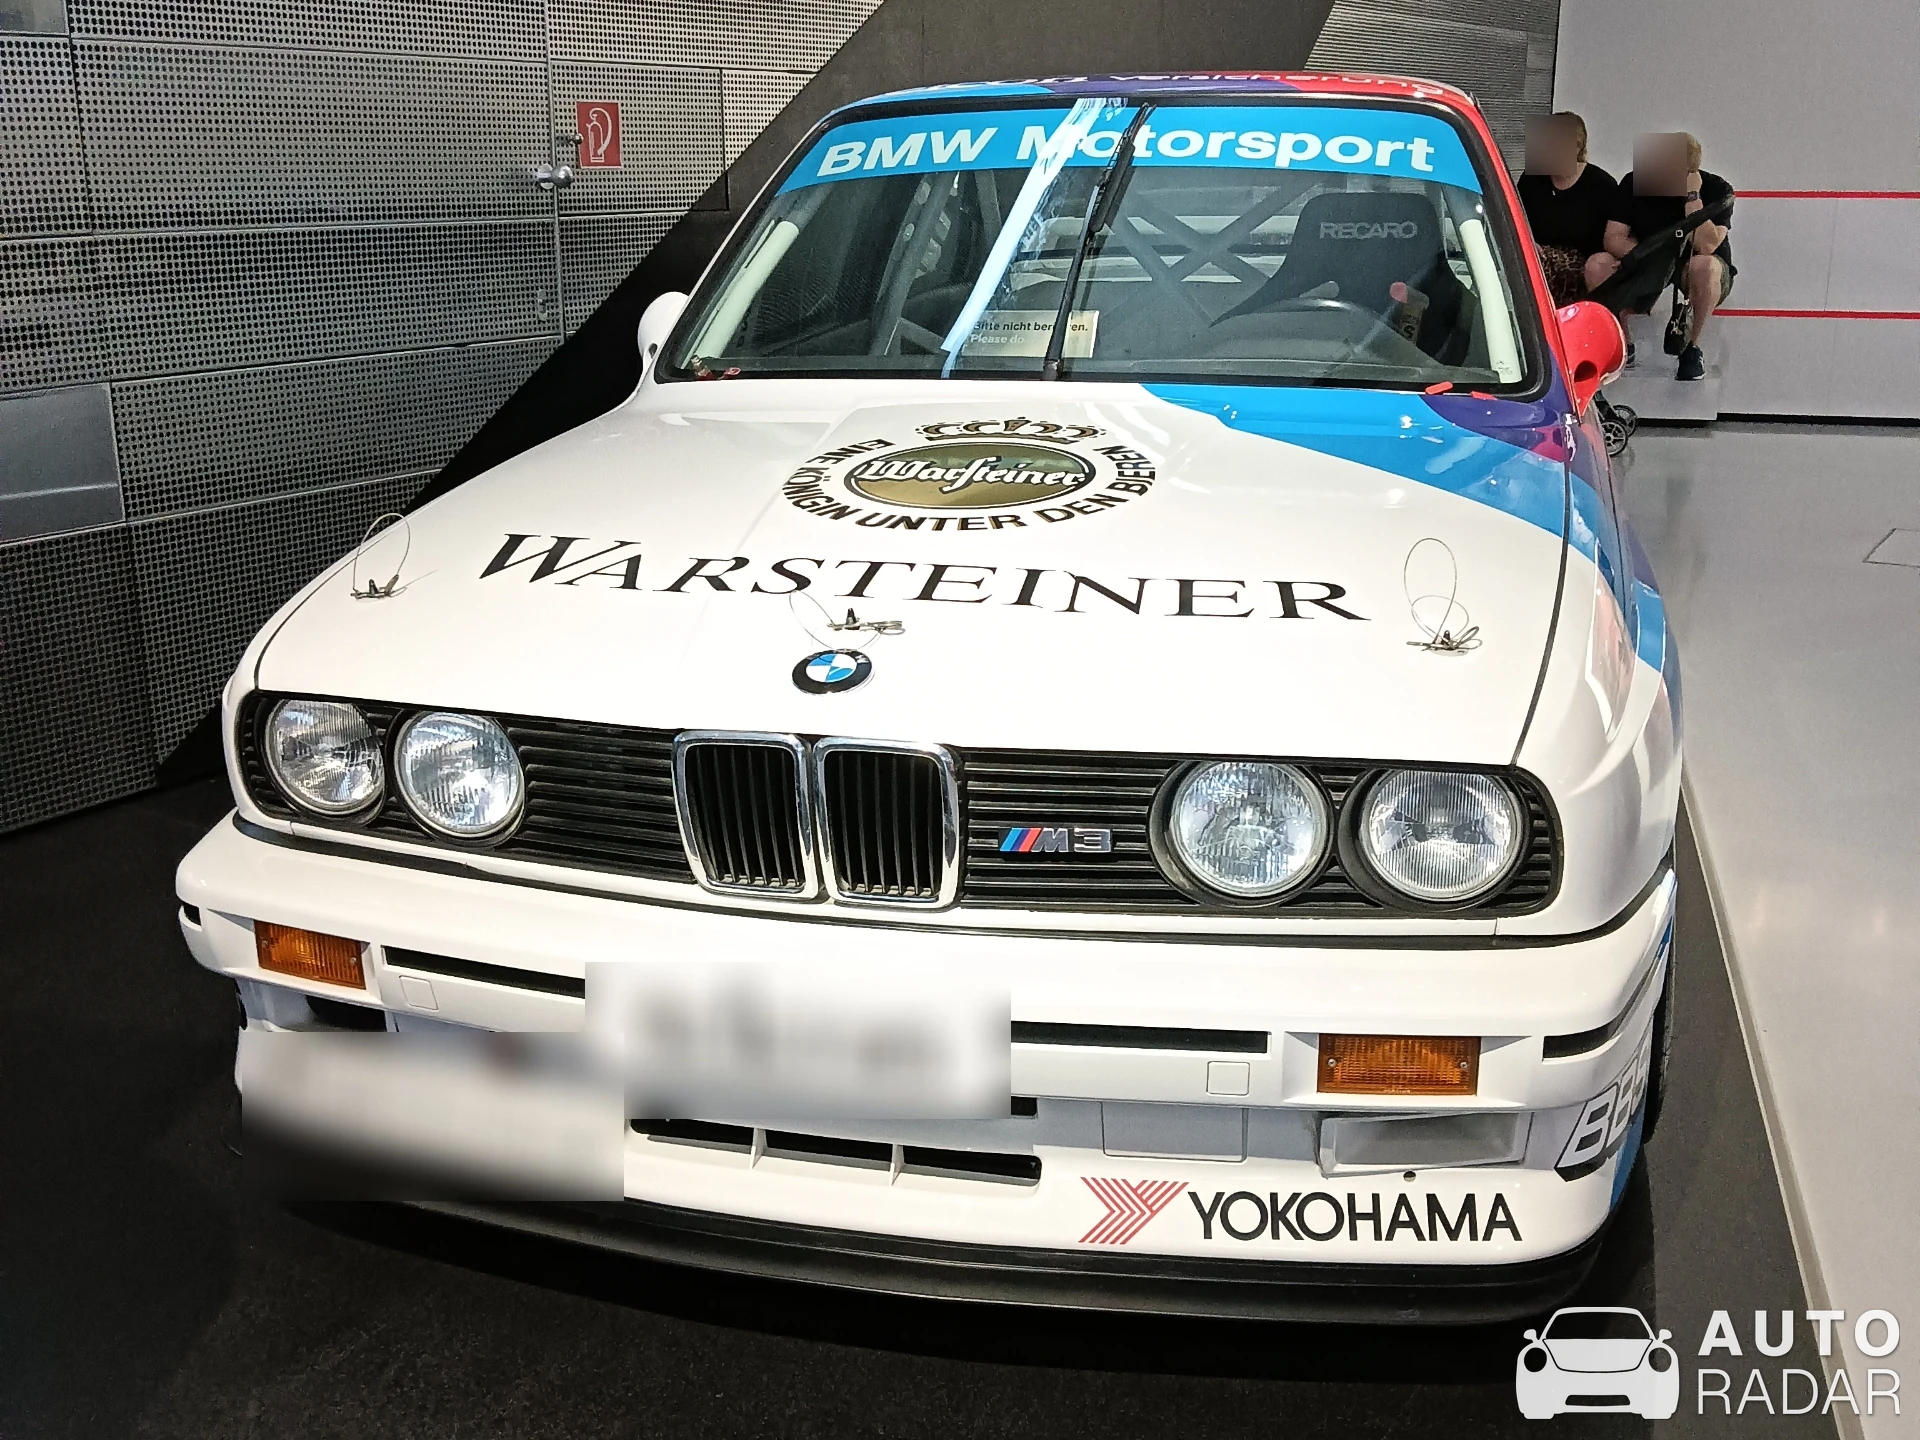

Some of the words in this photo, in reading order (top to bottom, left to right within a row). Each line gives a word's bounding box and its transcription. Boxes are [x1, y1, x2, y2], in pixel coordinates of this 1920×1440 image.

[817, 127, 998, 176] BMW
[1016, 124, 1435, 172] Motorsport
[1319, 221, 1418, 239] RECARO
[970, 332, 1008, 344] Please
[1009, 333, 1025, 344] do
[1002, 321, 1031, 331] nicht
[806, 438, 896, 465] EINE
[853, 457, 1086, 493] Warsteiner
[1092, 445, 1156, 496] BIEREN
[782, 466, 864, 520] KÖNIGIN
[855, 512, 1028, 531] UNTER
[1033, 494, 1130, 523] DEN
[478, 533, 1368, 621] WARSTEINER
[1030, 827, 1111, 853] M3
[1188, 1190, 1523, 1242] YOKOHAMA
